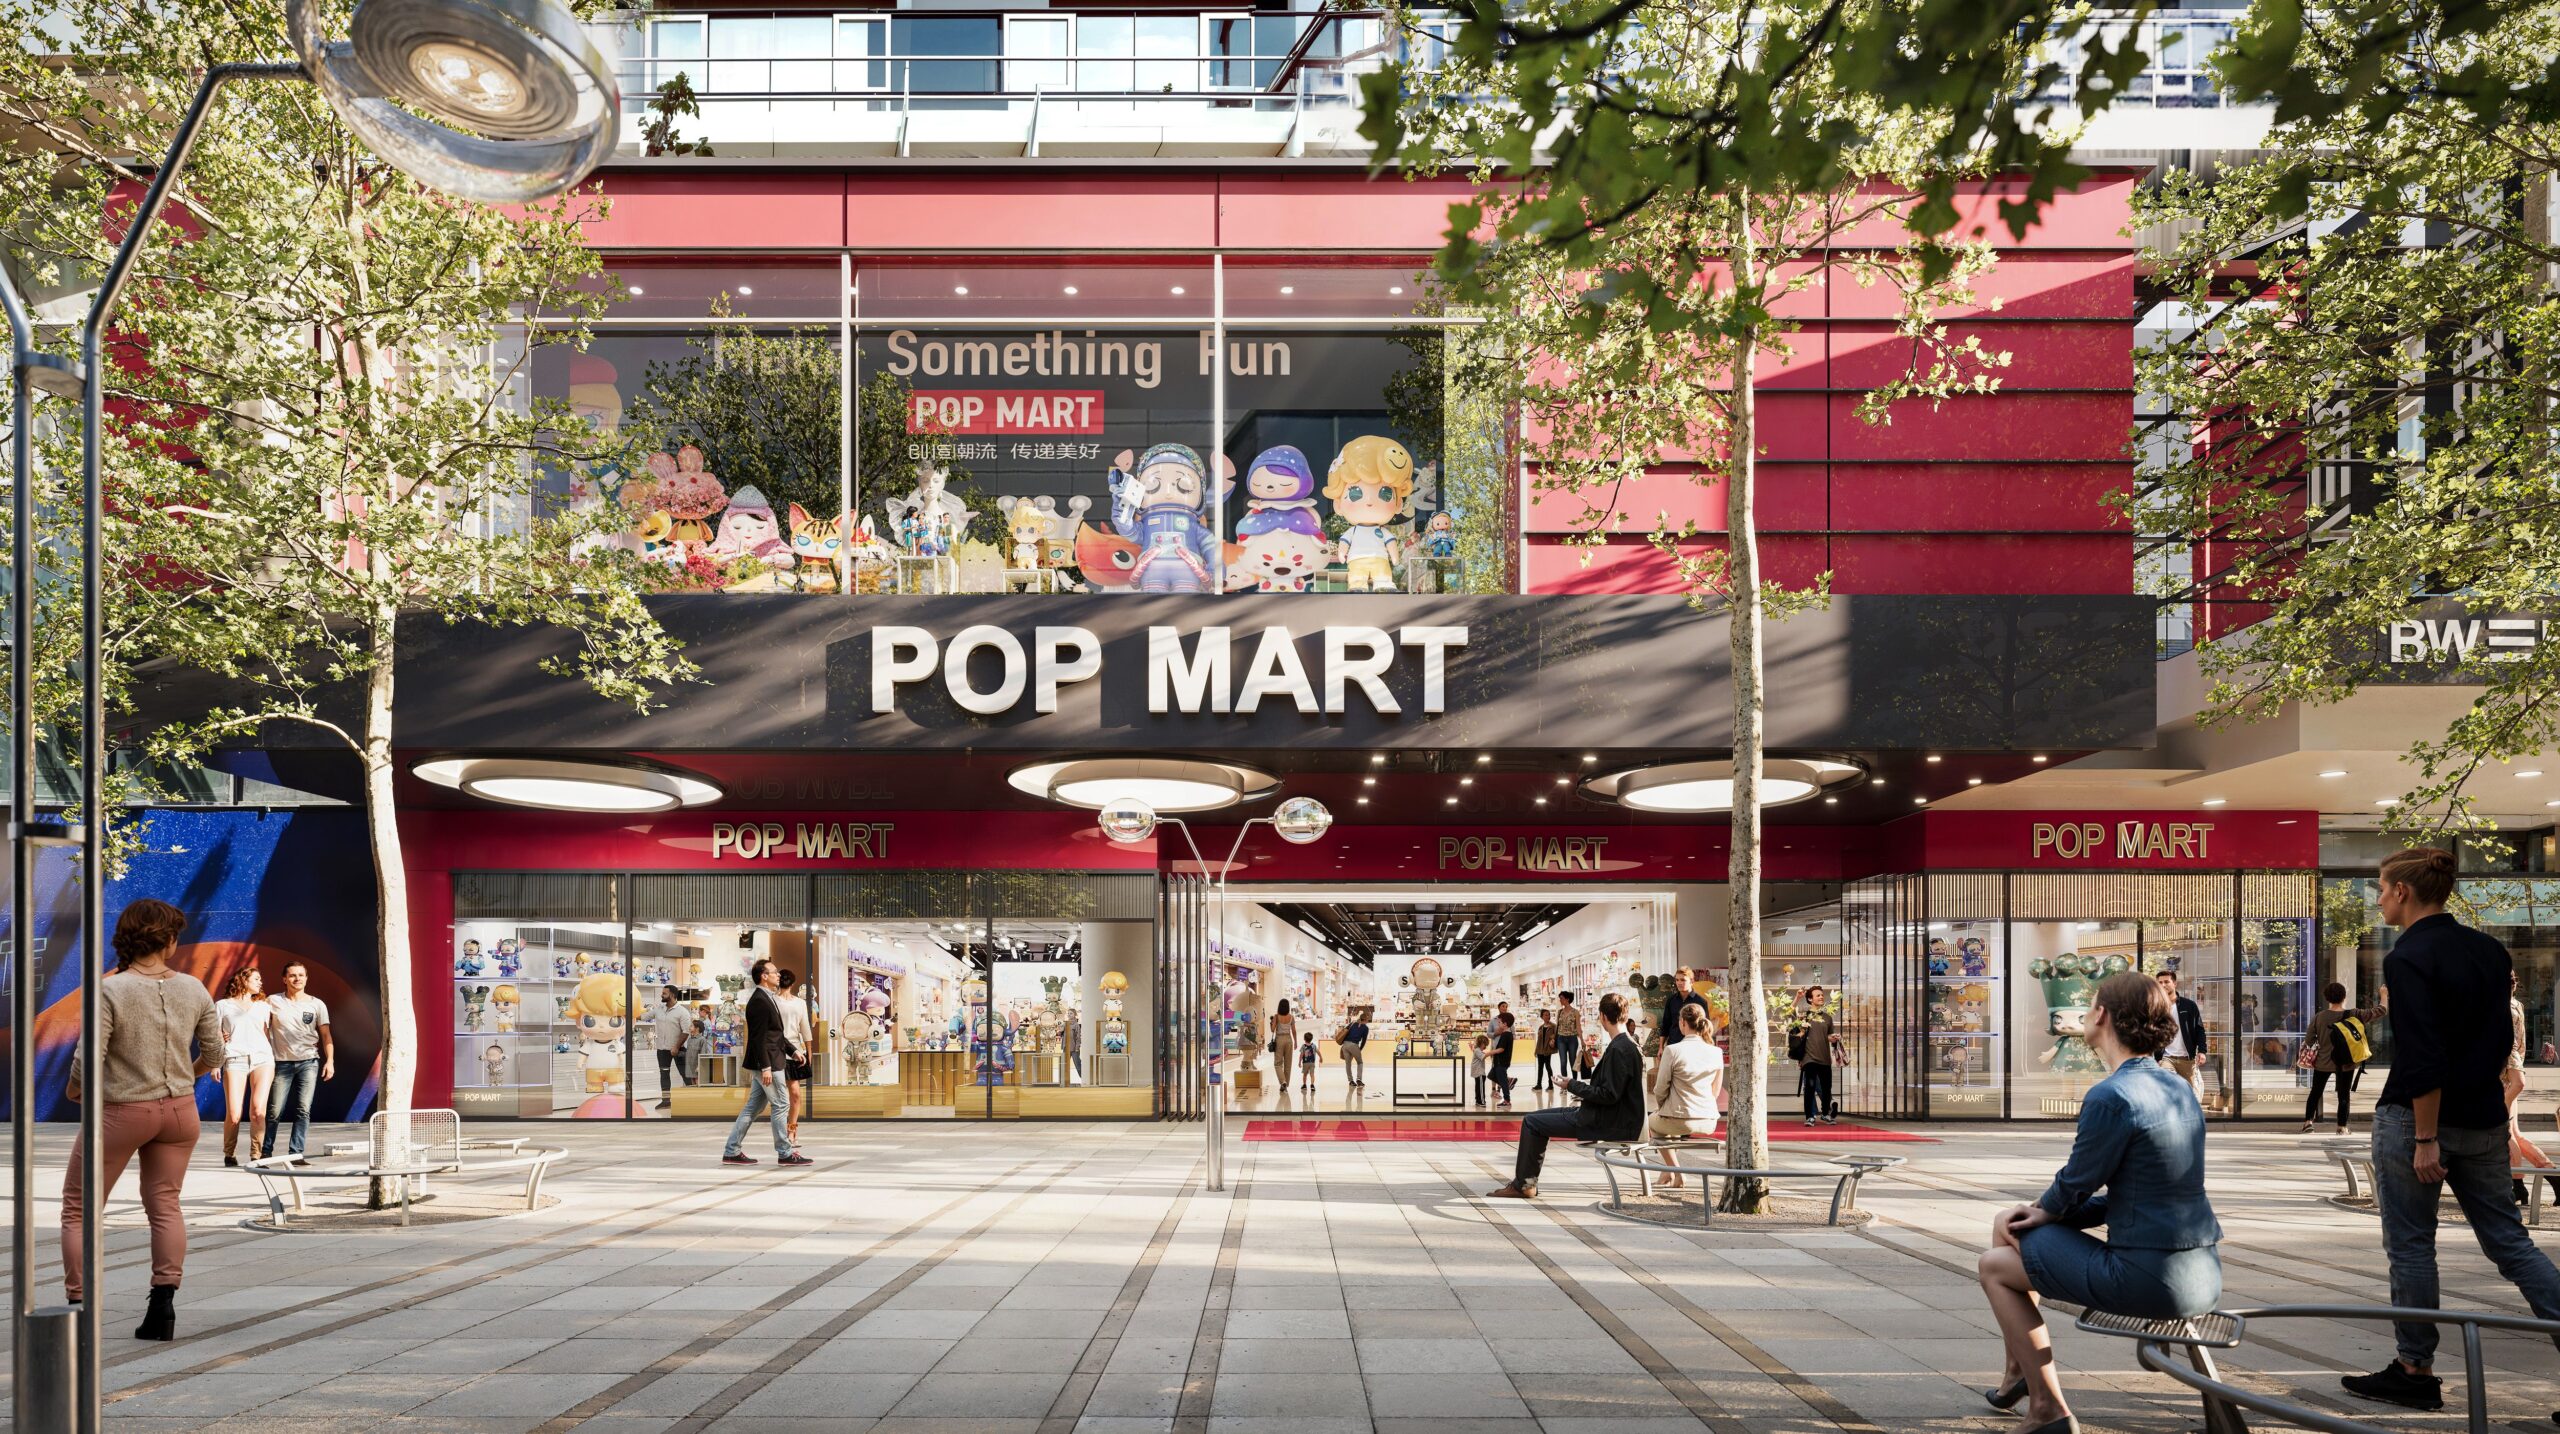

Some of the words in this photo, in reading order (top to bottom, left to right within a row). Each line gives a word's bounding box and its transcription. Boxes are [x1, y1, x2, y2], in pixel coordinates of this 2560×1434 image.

[886, 329, 1162, 390] Something
[1199, 330, 1292, 377] Fun
[914, 396, 984, 428] POP
[996, 396, 1096, 428] MART
[1010, 442, 1101, 461] 传递美好
[871, 624, 1102, 715] POP
[1148, 625, 1470, 714] MART
[712, 823, 785, 859] POP
[796, 823, 895, 858] MART
[2033, 823, 2106, 858] POP
[2116, 823, 2215, 858] MART
[1439, 837, 1507, 870] POP
[1517, 837, 1609, 870] MART
[1401, 976, 1408, 985] S
[1447, 977, 1454, 985] P
[829, 1029, 836, 1038] S
[464, 1093, 480, 1102] POP
[481, 1093, 501, 1102] MART
[1947, 1094, 1962, 1102] POP
[1964, 1094, 1984, 1102] MART
[2257, 1094, 2272, 1102] POP
[2274, 1094, 2294, 1102] MART
